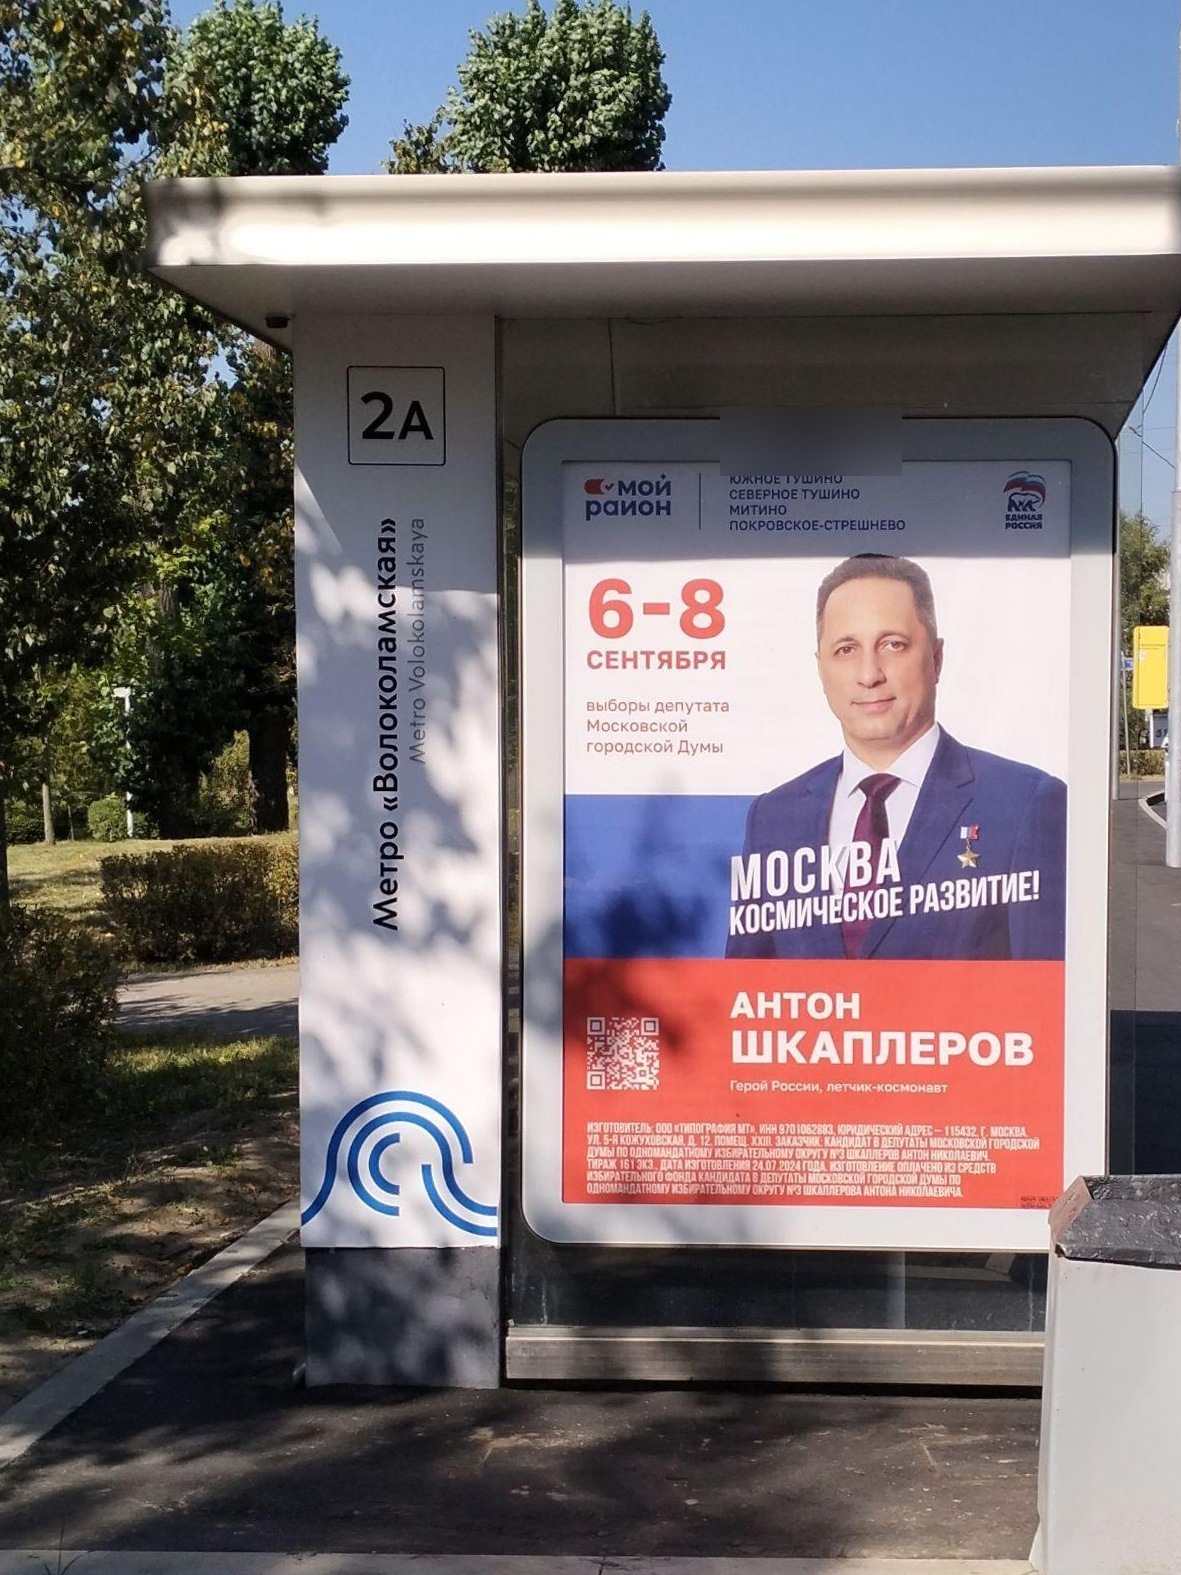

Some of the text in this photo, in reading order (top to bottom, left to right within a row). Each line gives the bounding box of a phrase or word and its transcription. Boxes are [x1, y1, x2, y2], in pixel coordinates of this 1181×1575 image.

[729, 475, 843, 484] ЮЖНОЕ ТУШИНО
[729, 489, 860, 500] СЕВЕРНОЕ ТУШИНО
[729, 505, 787, 516] МИТИНО
[729, 519, 906, 531] ПОКРОВСКОЕ-СТРЕШНЕВО
[406, 518, 428, 764] Metro Volokolamskaya
[586, 650, 726, 670] СЕНТЯБРЯ
[586, 698, 730, 715] выборы депутата
[373, 518, 404, 931] Метро «Волоколамская»
[586, 719, 688, 733] Московской
[586, 739, 724, 756] городской Думы
[730, 838, 901, 901] МОСКВА
[729, 870, 1040, 937] КОСМИЧЕСКОЕ РАЗВИТИЕ!
[730, 991, 860, 1020] АНТОН
[731, 1030, 1034, 1067] ШКАПЛЕРОВ
[730, 1079, 948, 1094] Герой России, летчик-космонавт
[656, 1122, 673, 1134] ООО
[760, 1123, 777, 1135] ИНН
[905, 1124, 933, 1137] АДРЕС
[824, 1136, 872, 1148] КАНДИДАТ
[873, 1137, 880, 1148] В
[881, 1137, 928, 1148] ДЕПУТАТЫ
[929, 1137, 987, 1149] МОСКОВСКОЙ
[989, 1137, 1040, 1150] ГОРОДСКОЙ
[587, 1146, 615, 1158] ДУМЫ
[617, 1146, 628, 1158] ПО
[630, 1147, 712, 1159] ОДНОМАНДАТНОМУ
[795, 1148, 828, 1160] ОКРУГУ
[846, 1149, 899, 1160] ШКАПЛЕРОВ
[901, 1149, 929, 1161] АНТОН
[587, 1158, 617, 1170] ТИРАЖ
[660, 1159, 683, 1171] ДАТА
[665, 1171, 697, 1183] ФОНДА
[699, 1171, 751, 1183] КАНДИДАТА
[760, 1172, 807, 1184] ДЕПУТАТЫ
[919, 1174, 947, 1186] ДУМЫ
[752, 1184, 785, 1195] ОКРУГУ
[863, 1185, 897, 1197] АНТОНА
